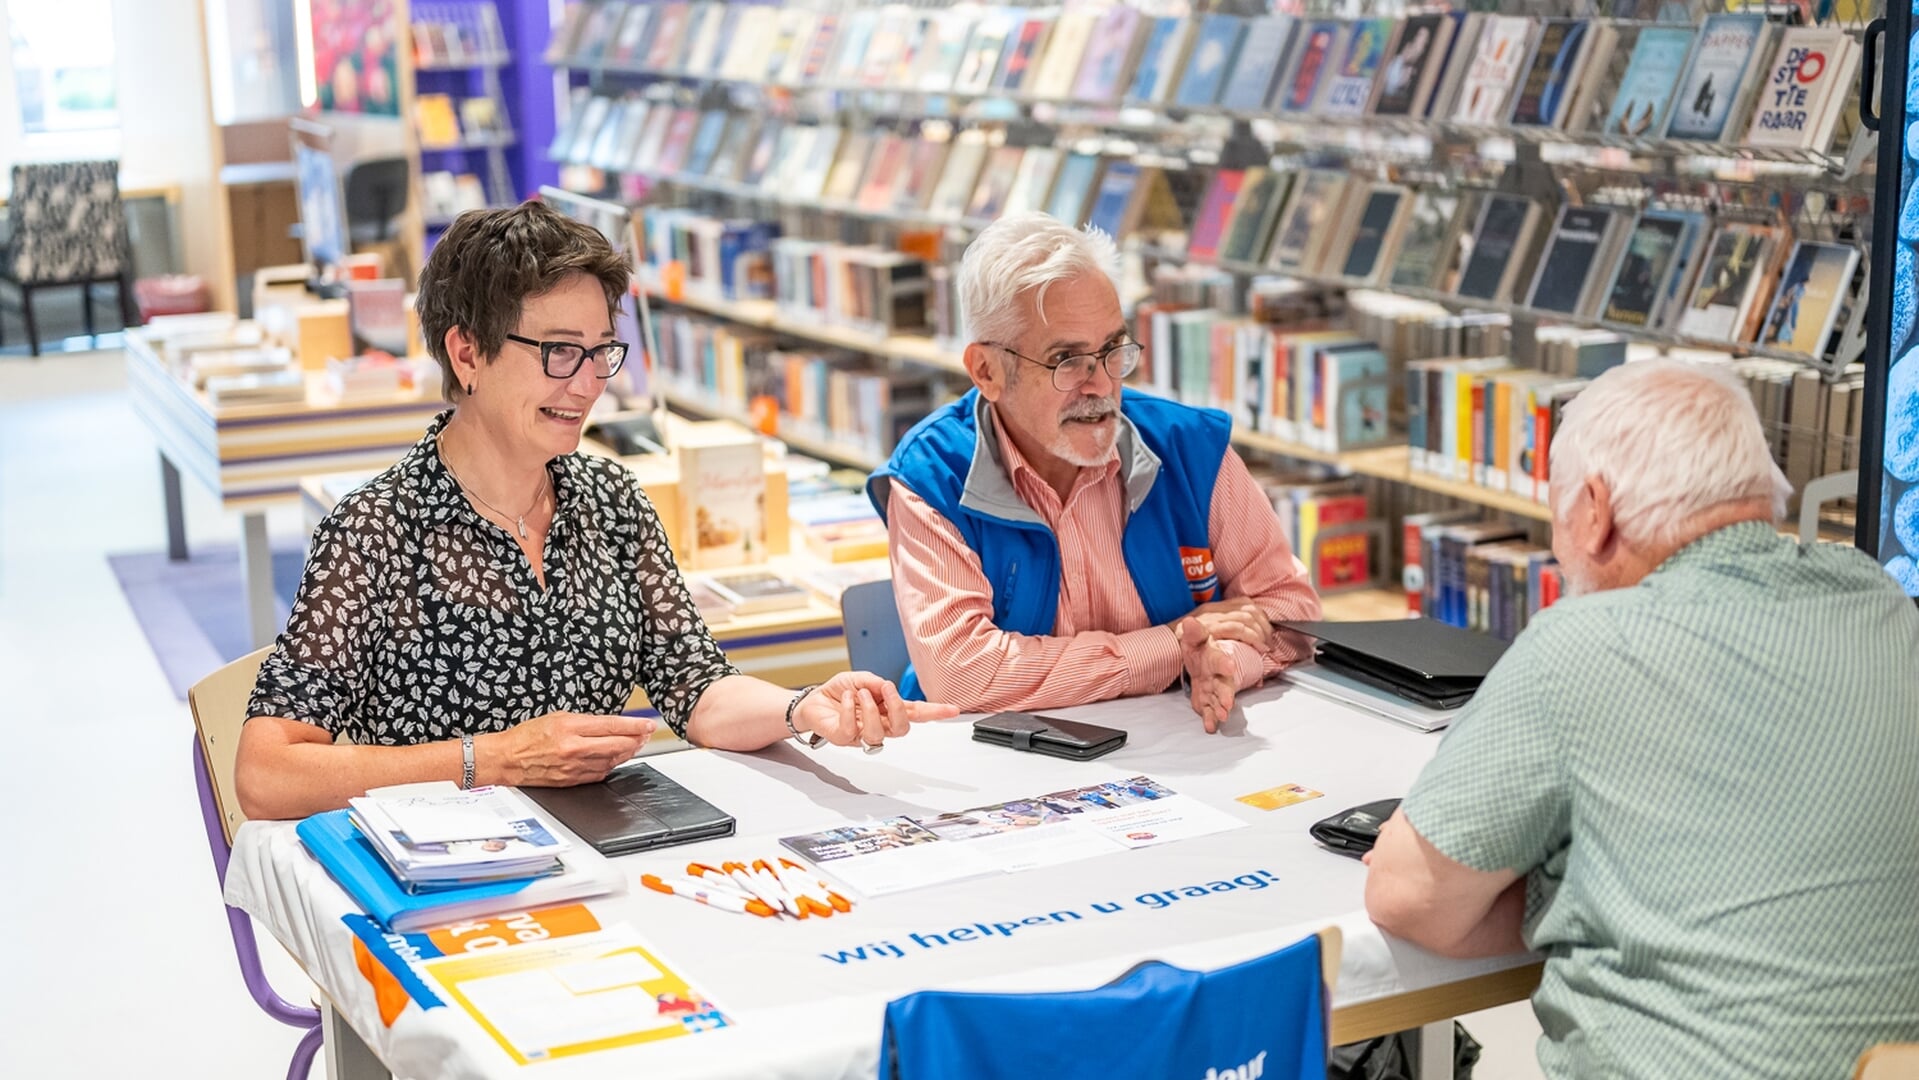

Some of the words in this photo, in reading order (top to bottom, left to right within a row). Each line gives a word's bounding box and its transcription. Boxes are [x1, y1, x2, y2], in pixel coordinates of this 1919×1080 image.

[1187, 565, 1204, 576] OV
[820, 940, 906, 965] Wij
[908, 910, 1083, 949] helpen
[1090, 901, 1125, 914] u
[1135, 869, 1280, 909] graag!
